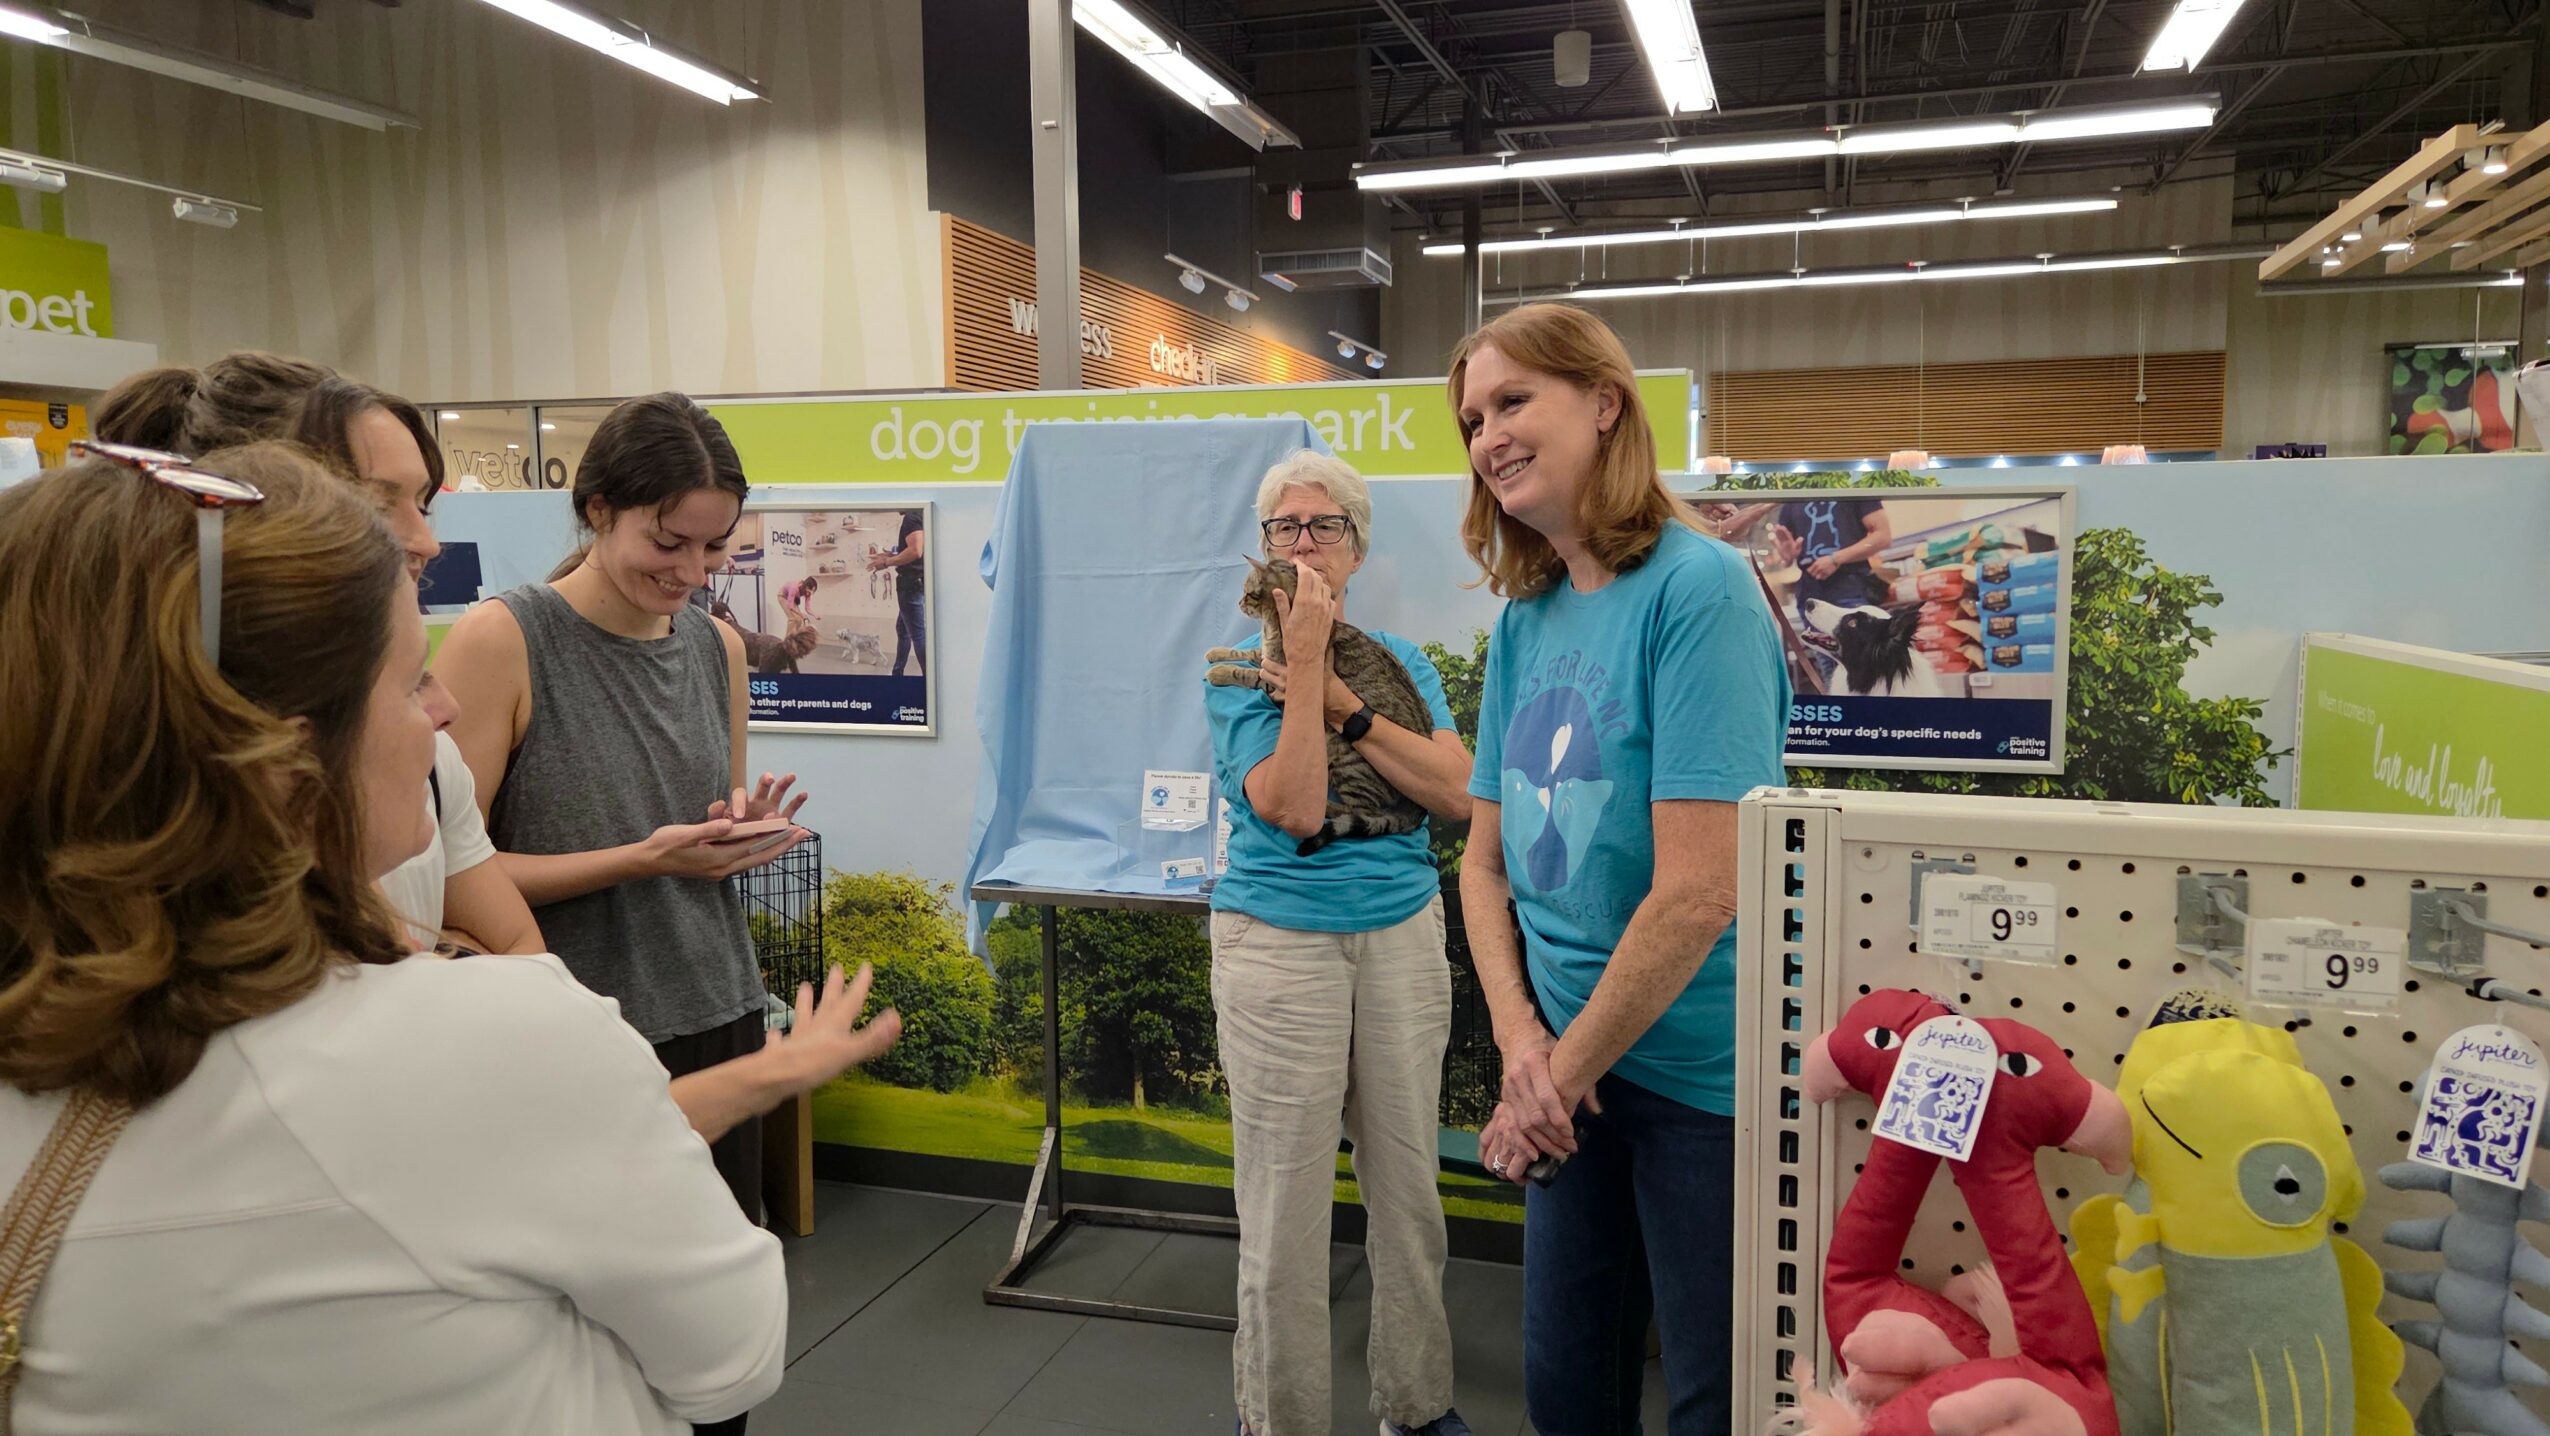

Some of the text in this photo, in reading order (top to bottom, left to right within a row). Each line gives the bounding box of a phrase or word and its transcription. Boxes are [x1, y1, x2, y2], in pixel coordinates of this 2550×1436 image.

[870, 407, 984, 474] dog
[1267, 393, 1415, 451] ark
[772, 530, 803, 547] petco
[748, 681, 779, 695] SES
[1545, 649, 1630, 740] FOR LIFE NC
[757, 697, 781, 707] other
[781, 699, 796, 710] pet
[798, 699, 831, 710] parents
[832, 699, 849, 709] and
[850, 700, 872, 711] dogs
[1804, 725, 1823, 736] for
[1825, 727, 1853, 738] your
[1855, 727, 1888, 740] dog's
[1891, 727, 1941, 740] specific
[1943, 729, 1982, 740] needs
[2010, 738, 2046, 747] positive
[2010, 746, 2046, 757] training
[2373, 723, 2402, 790] love
[2405, 743, 2437, 807] and
[1918, 1025, 1988, 1050] jupiter
[2451, 1036, 2537, 1065] jupiter
